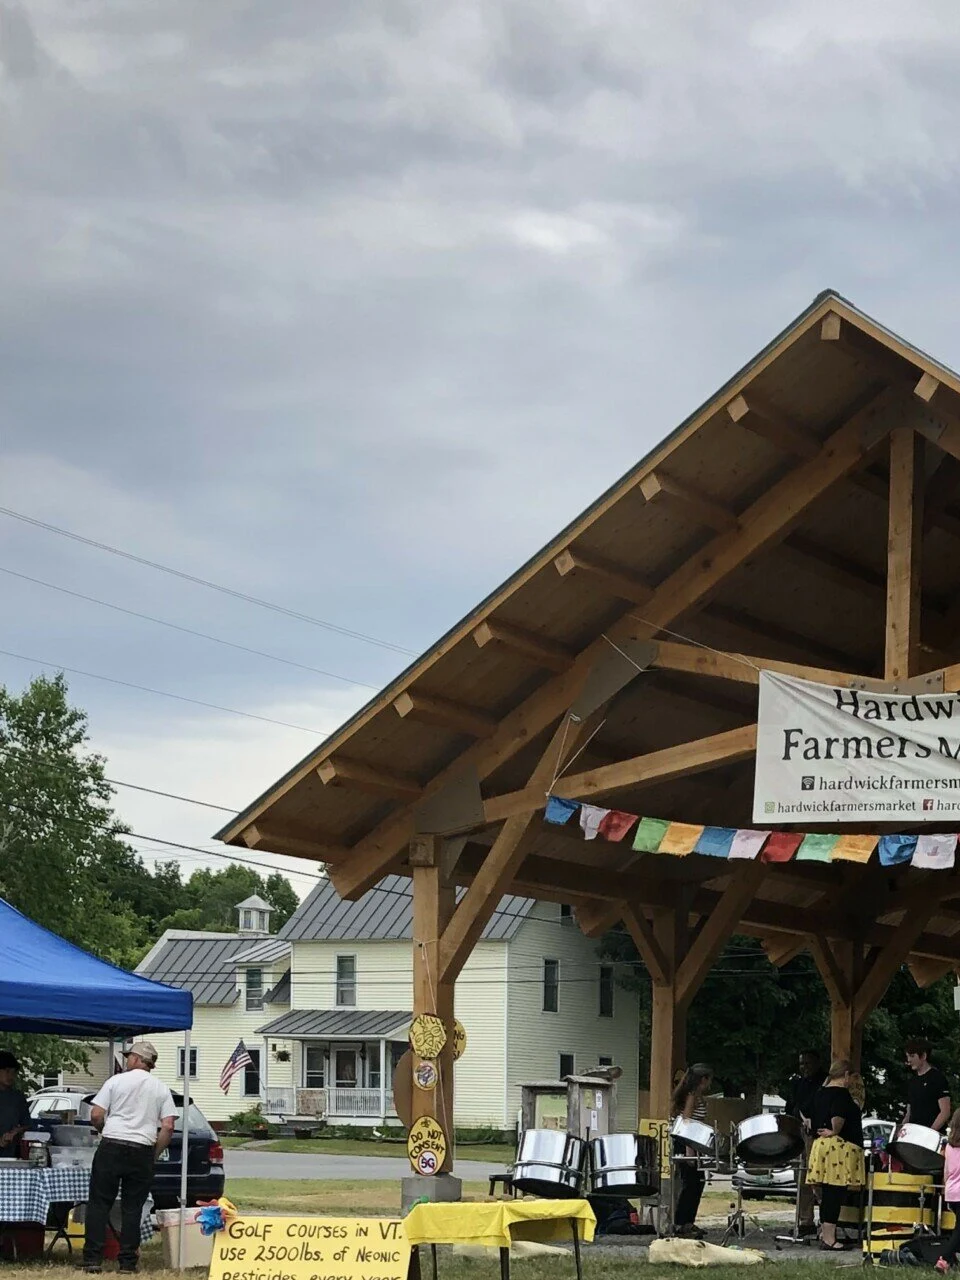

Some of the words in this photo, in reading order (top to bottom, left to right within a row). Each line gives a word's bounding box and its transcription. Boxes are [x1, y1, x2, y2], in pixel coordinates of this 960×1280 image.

[782, 729, 931, 760] Farmers
[778, 800, 916, 813] hardwickfarmersmarket
[411, 1132, 423, 1143] DO
[427, 1129, 443, 1141] NOT
[410, 1140, 445, 1159] CONSENT
[421, 1158, 435, 1168] 5G
[380, 1222, 403, 1240] VT.
[333, 1246, 350, 1262] of
[356, 1246, 400, 1263] NEONIC
